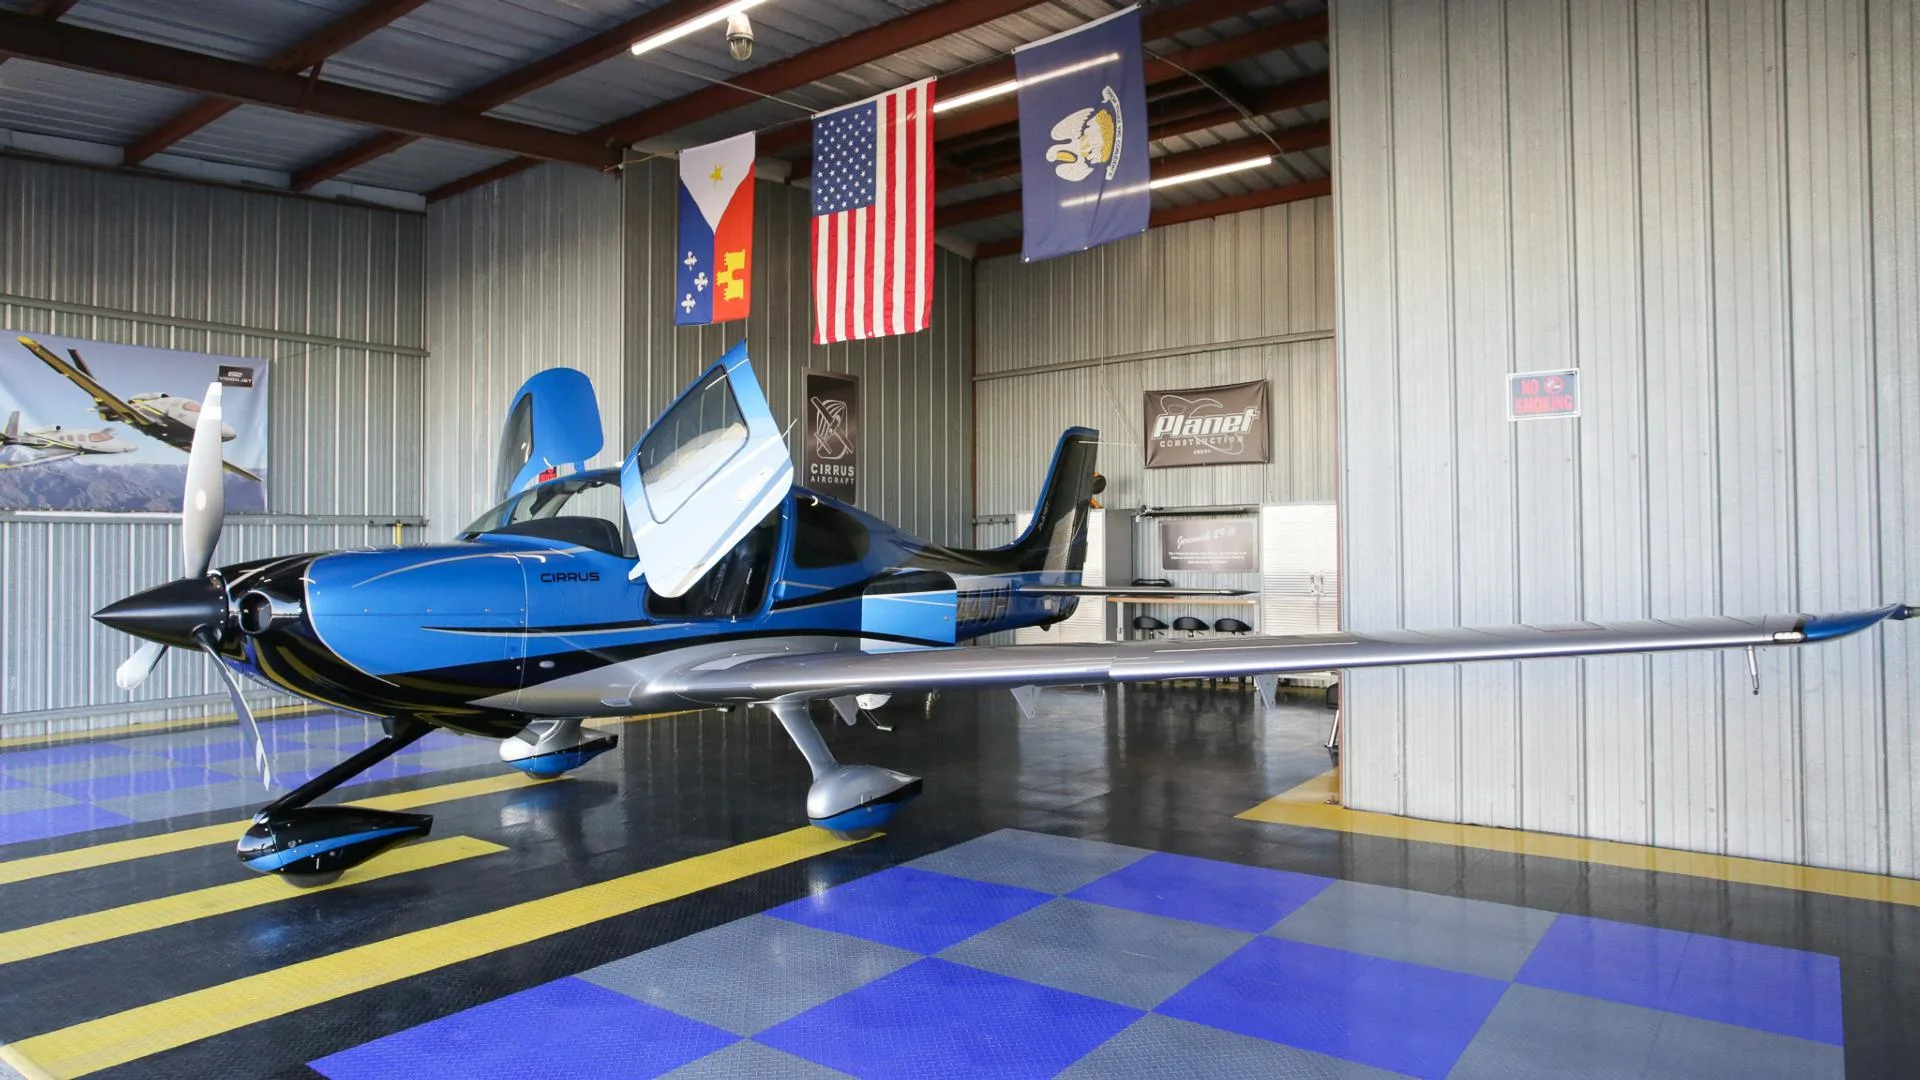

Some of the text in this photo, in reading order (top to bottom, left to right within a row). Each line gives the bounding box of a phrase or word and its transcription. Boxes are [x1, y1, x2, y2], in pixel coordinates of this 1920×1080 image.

[1521, 378, 1539, 395] NO
[1515, 394, 1574, 413] SMOKING
[1152, 407, 1260, 439] Planet
[811, 463, 855, 477] CIRRUS
[811, 475, 854, 484] AIRCRAFT
[540, 572, 600, 583] CIRRUS
